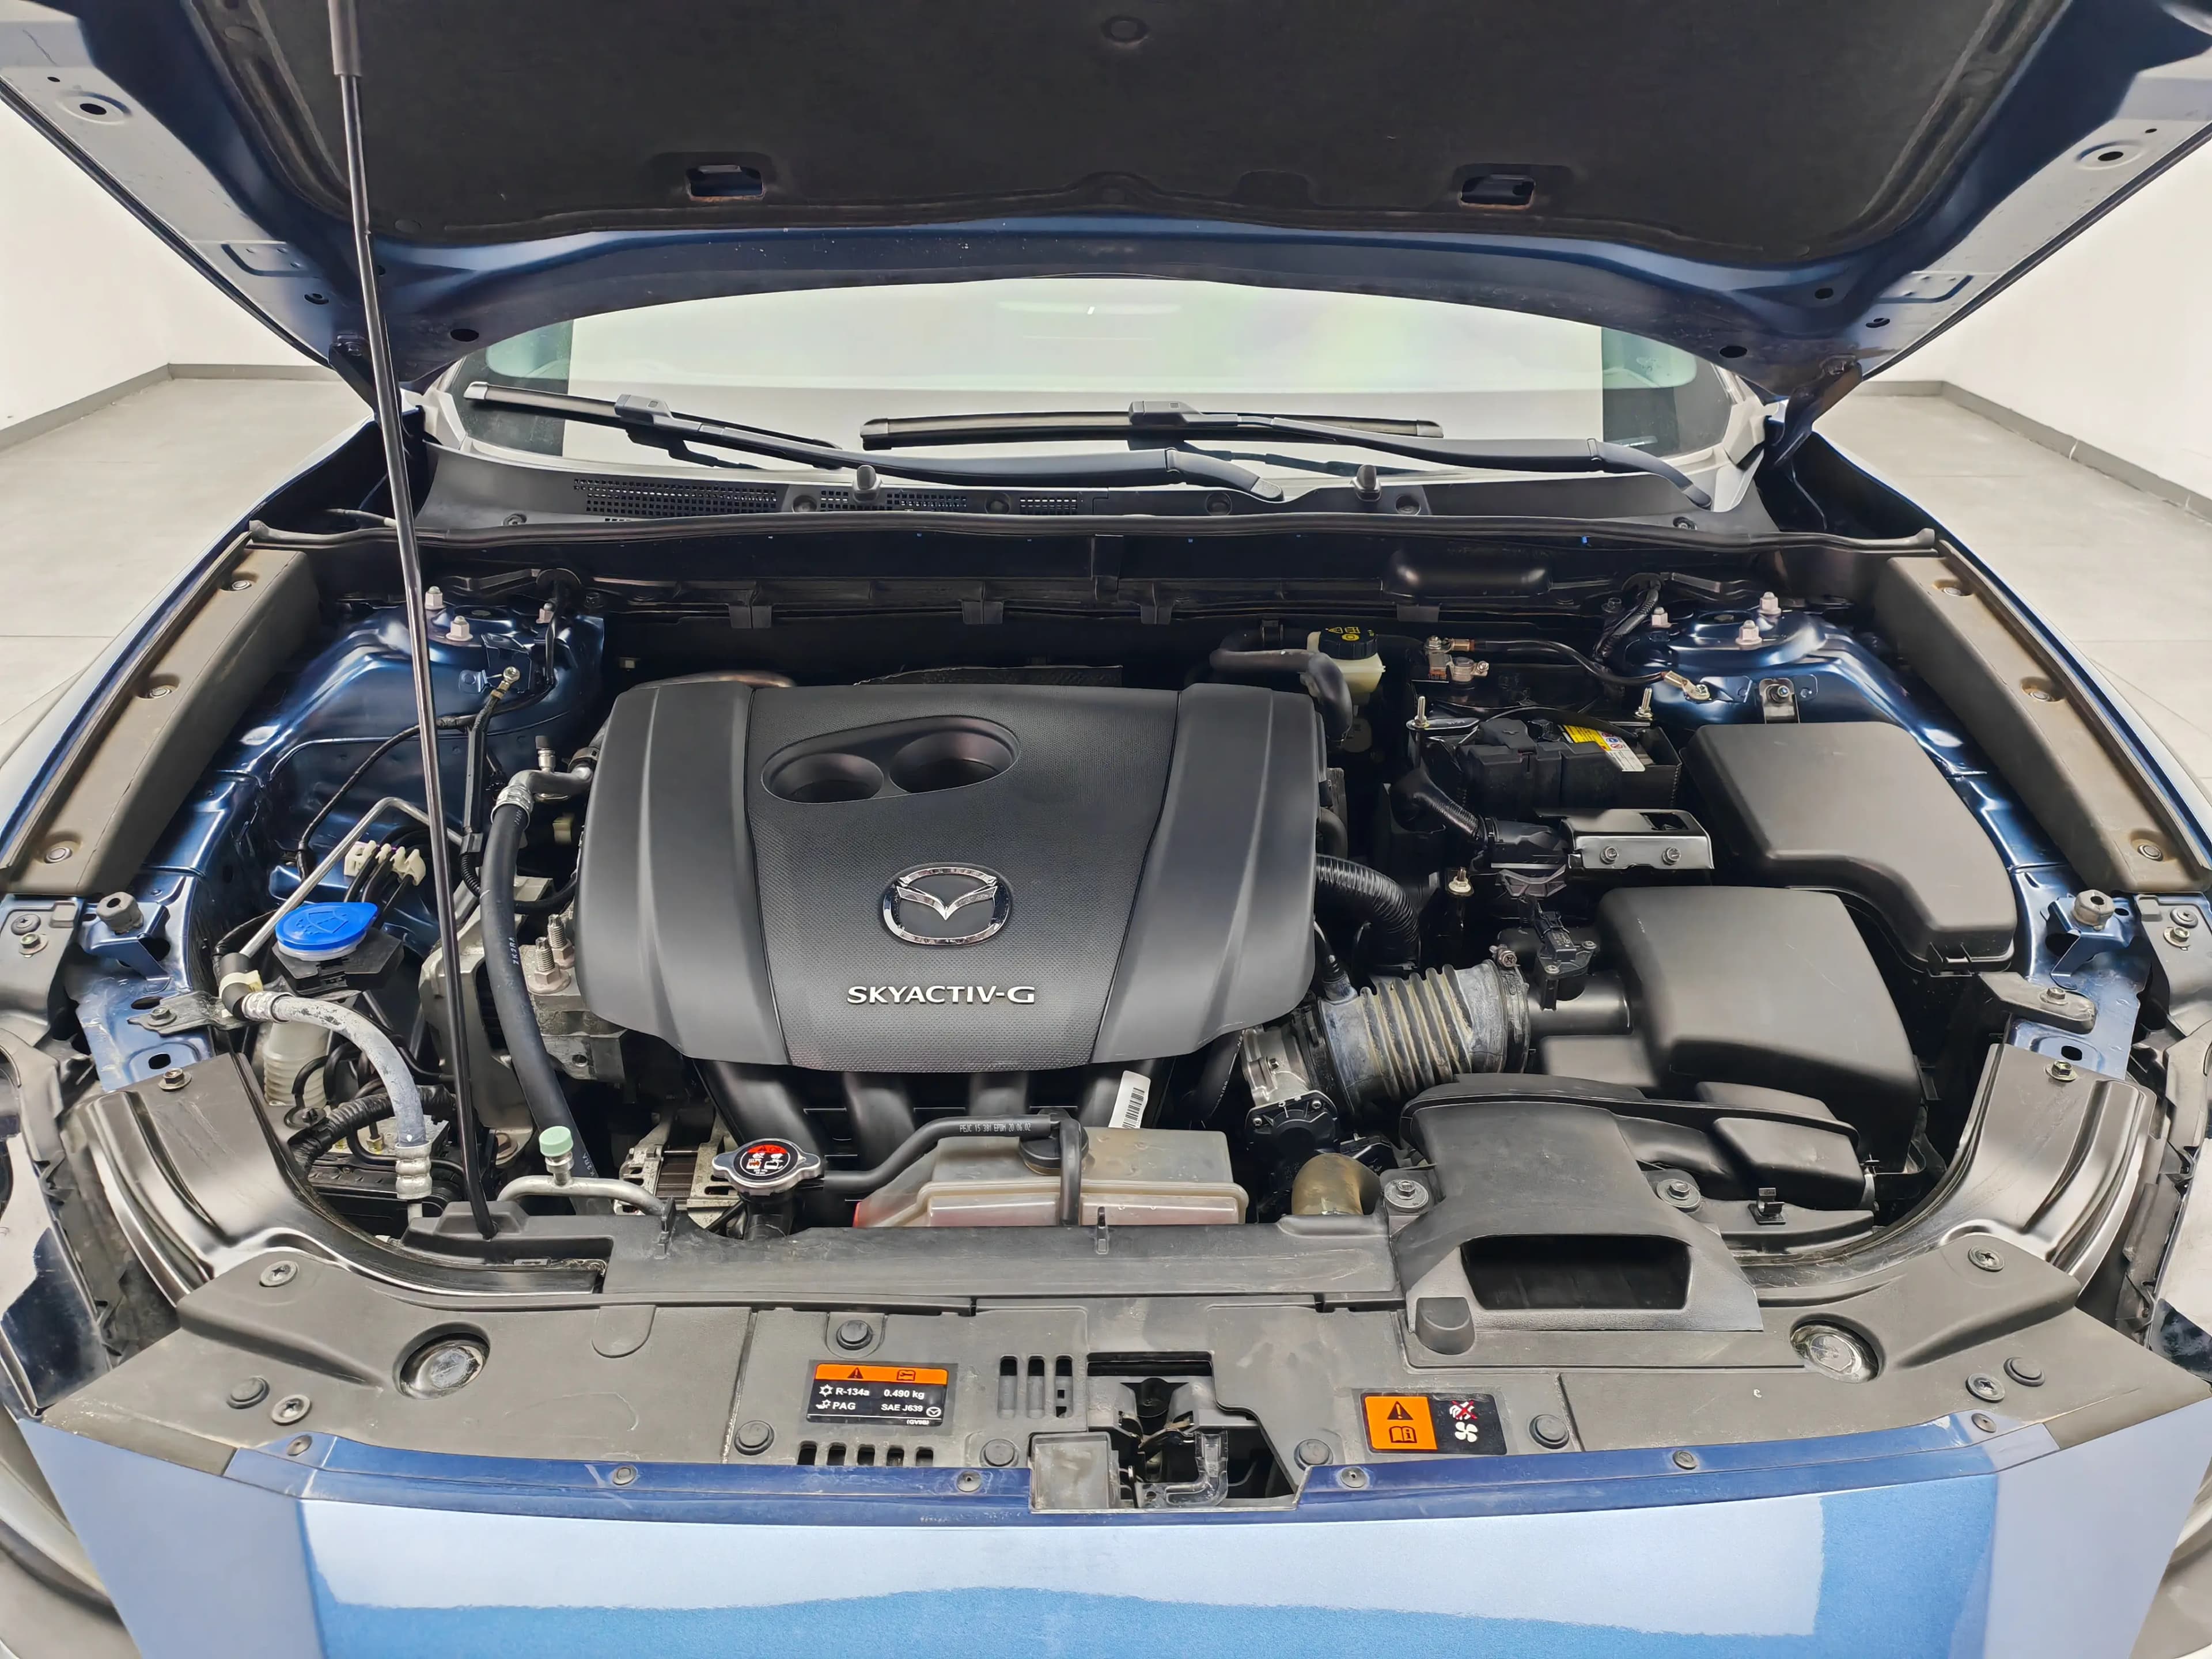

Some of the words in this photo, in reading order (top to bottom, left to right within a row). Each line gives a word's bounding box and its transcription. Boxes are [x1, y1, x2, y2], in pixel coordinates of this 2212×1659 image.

[846, 985, 1036, 1005] SKYACTIV-G
[835, 1387, 870, 1396] R-134a
[884, 1389, 910, 1398] 0.490
[912, 1390, 925, 1400] kg
[832, 1401, 857, 1410] PAG
[881, 1403, 902, 1411] SAE
